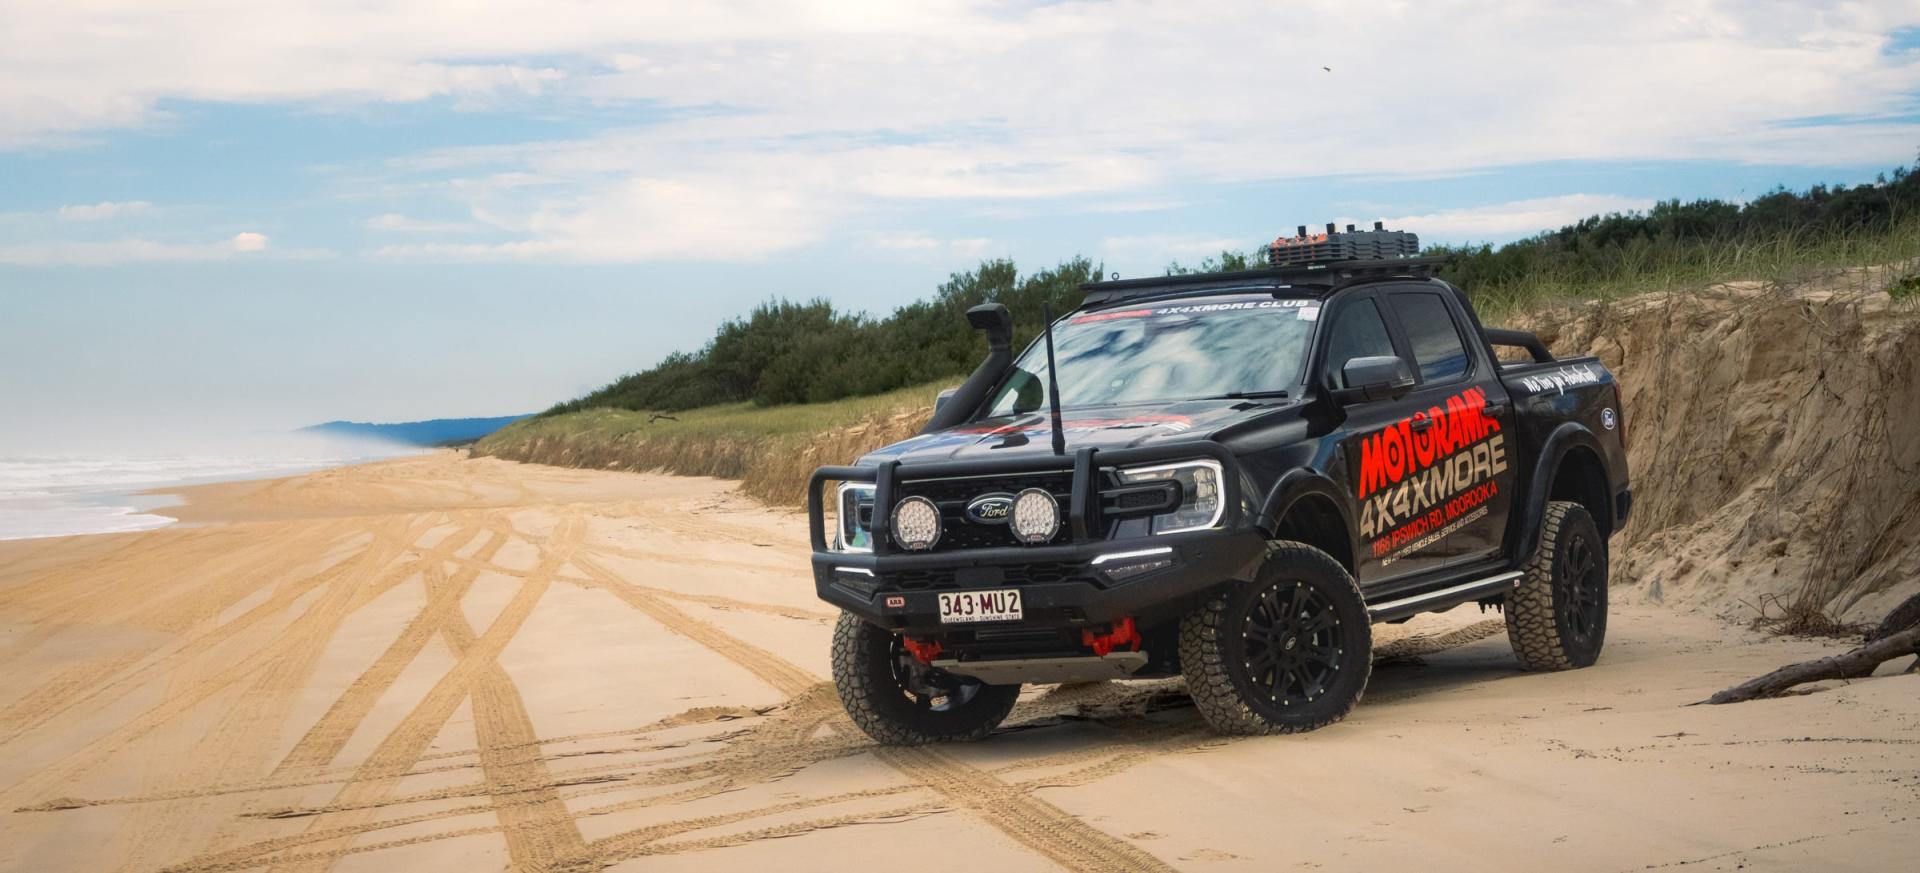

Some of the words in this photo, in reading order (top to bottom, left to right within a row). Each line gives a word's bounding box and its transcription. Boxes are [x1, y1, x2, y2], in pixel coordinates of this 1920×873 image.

[1156, 302, 1255, 315] 4X4XMORE
[1259, 300, 1308, 309] CLUB
[1359, 385, 1500, 499] MOTORAMA
[980, 502, 1008, 517] Ford
[1360, 434, 1507, 539] 4X4XMORE
[1372, 536, 1391, 558] 1166
[1392, 515, 1429, 548] IPSWICH
[1445, 481, 1498, 521] MOOROOKA
